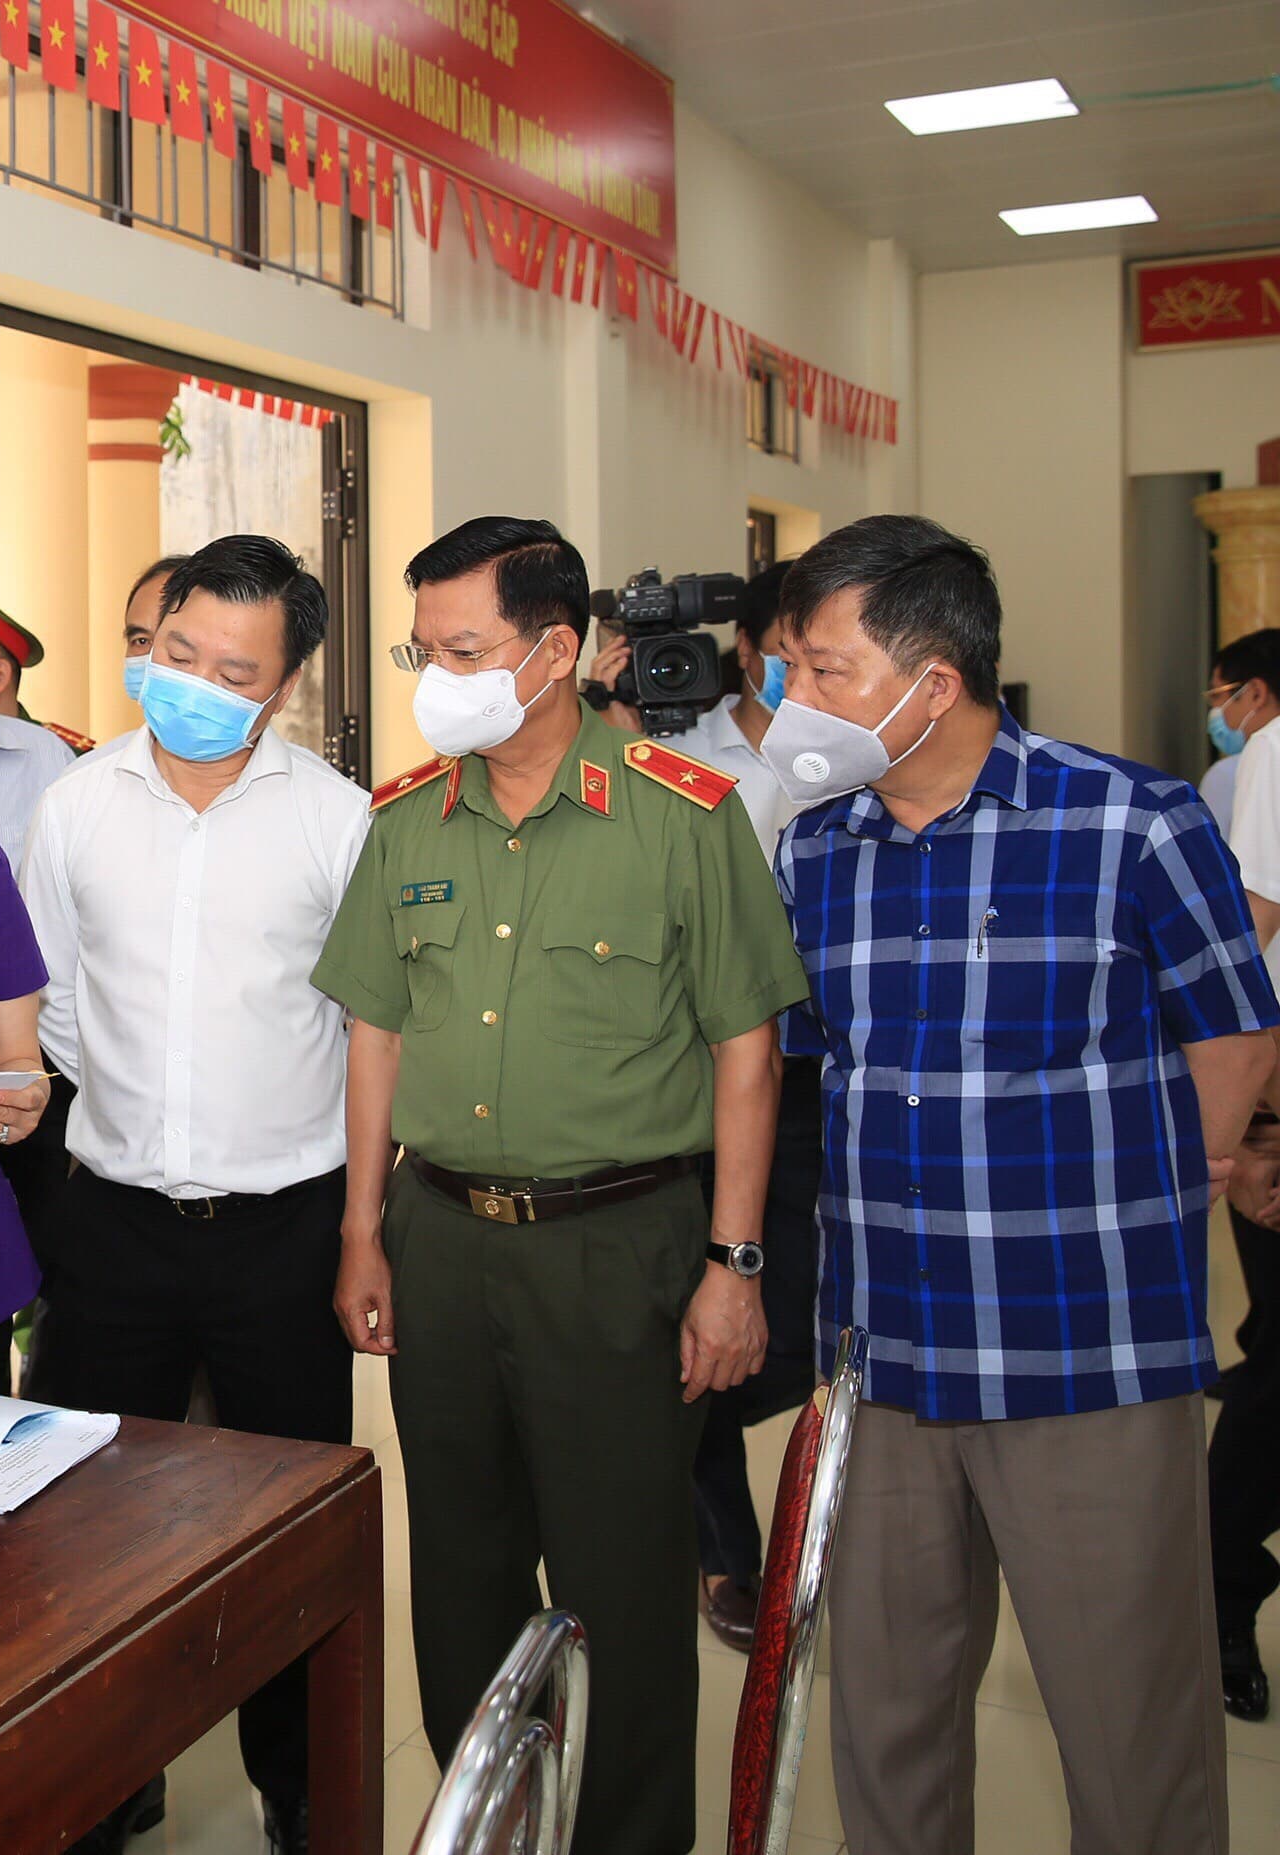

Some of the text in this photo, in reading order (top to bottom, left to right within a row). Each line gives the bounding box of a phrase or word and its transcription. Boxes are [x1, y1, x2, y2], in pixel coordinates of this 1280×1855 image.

[332, 7, 373, 88] NAM
[377, 20, 410, 109] CỦA
[414, 54, 457, 133] NHÂN
[497, 103, 517, 164] DO
[519, 114, 556, 185] NHÂN
